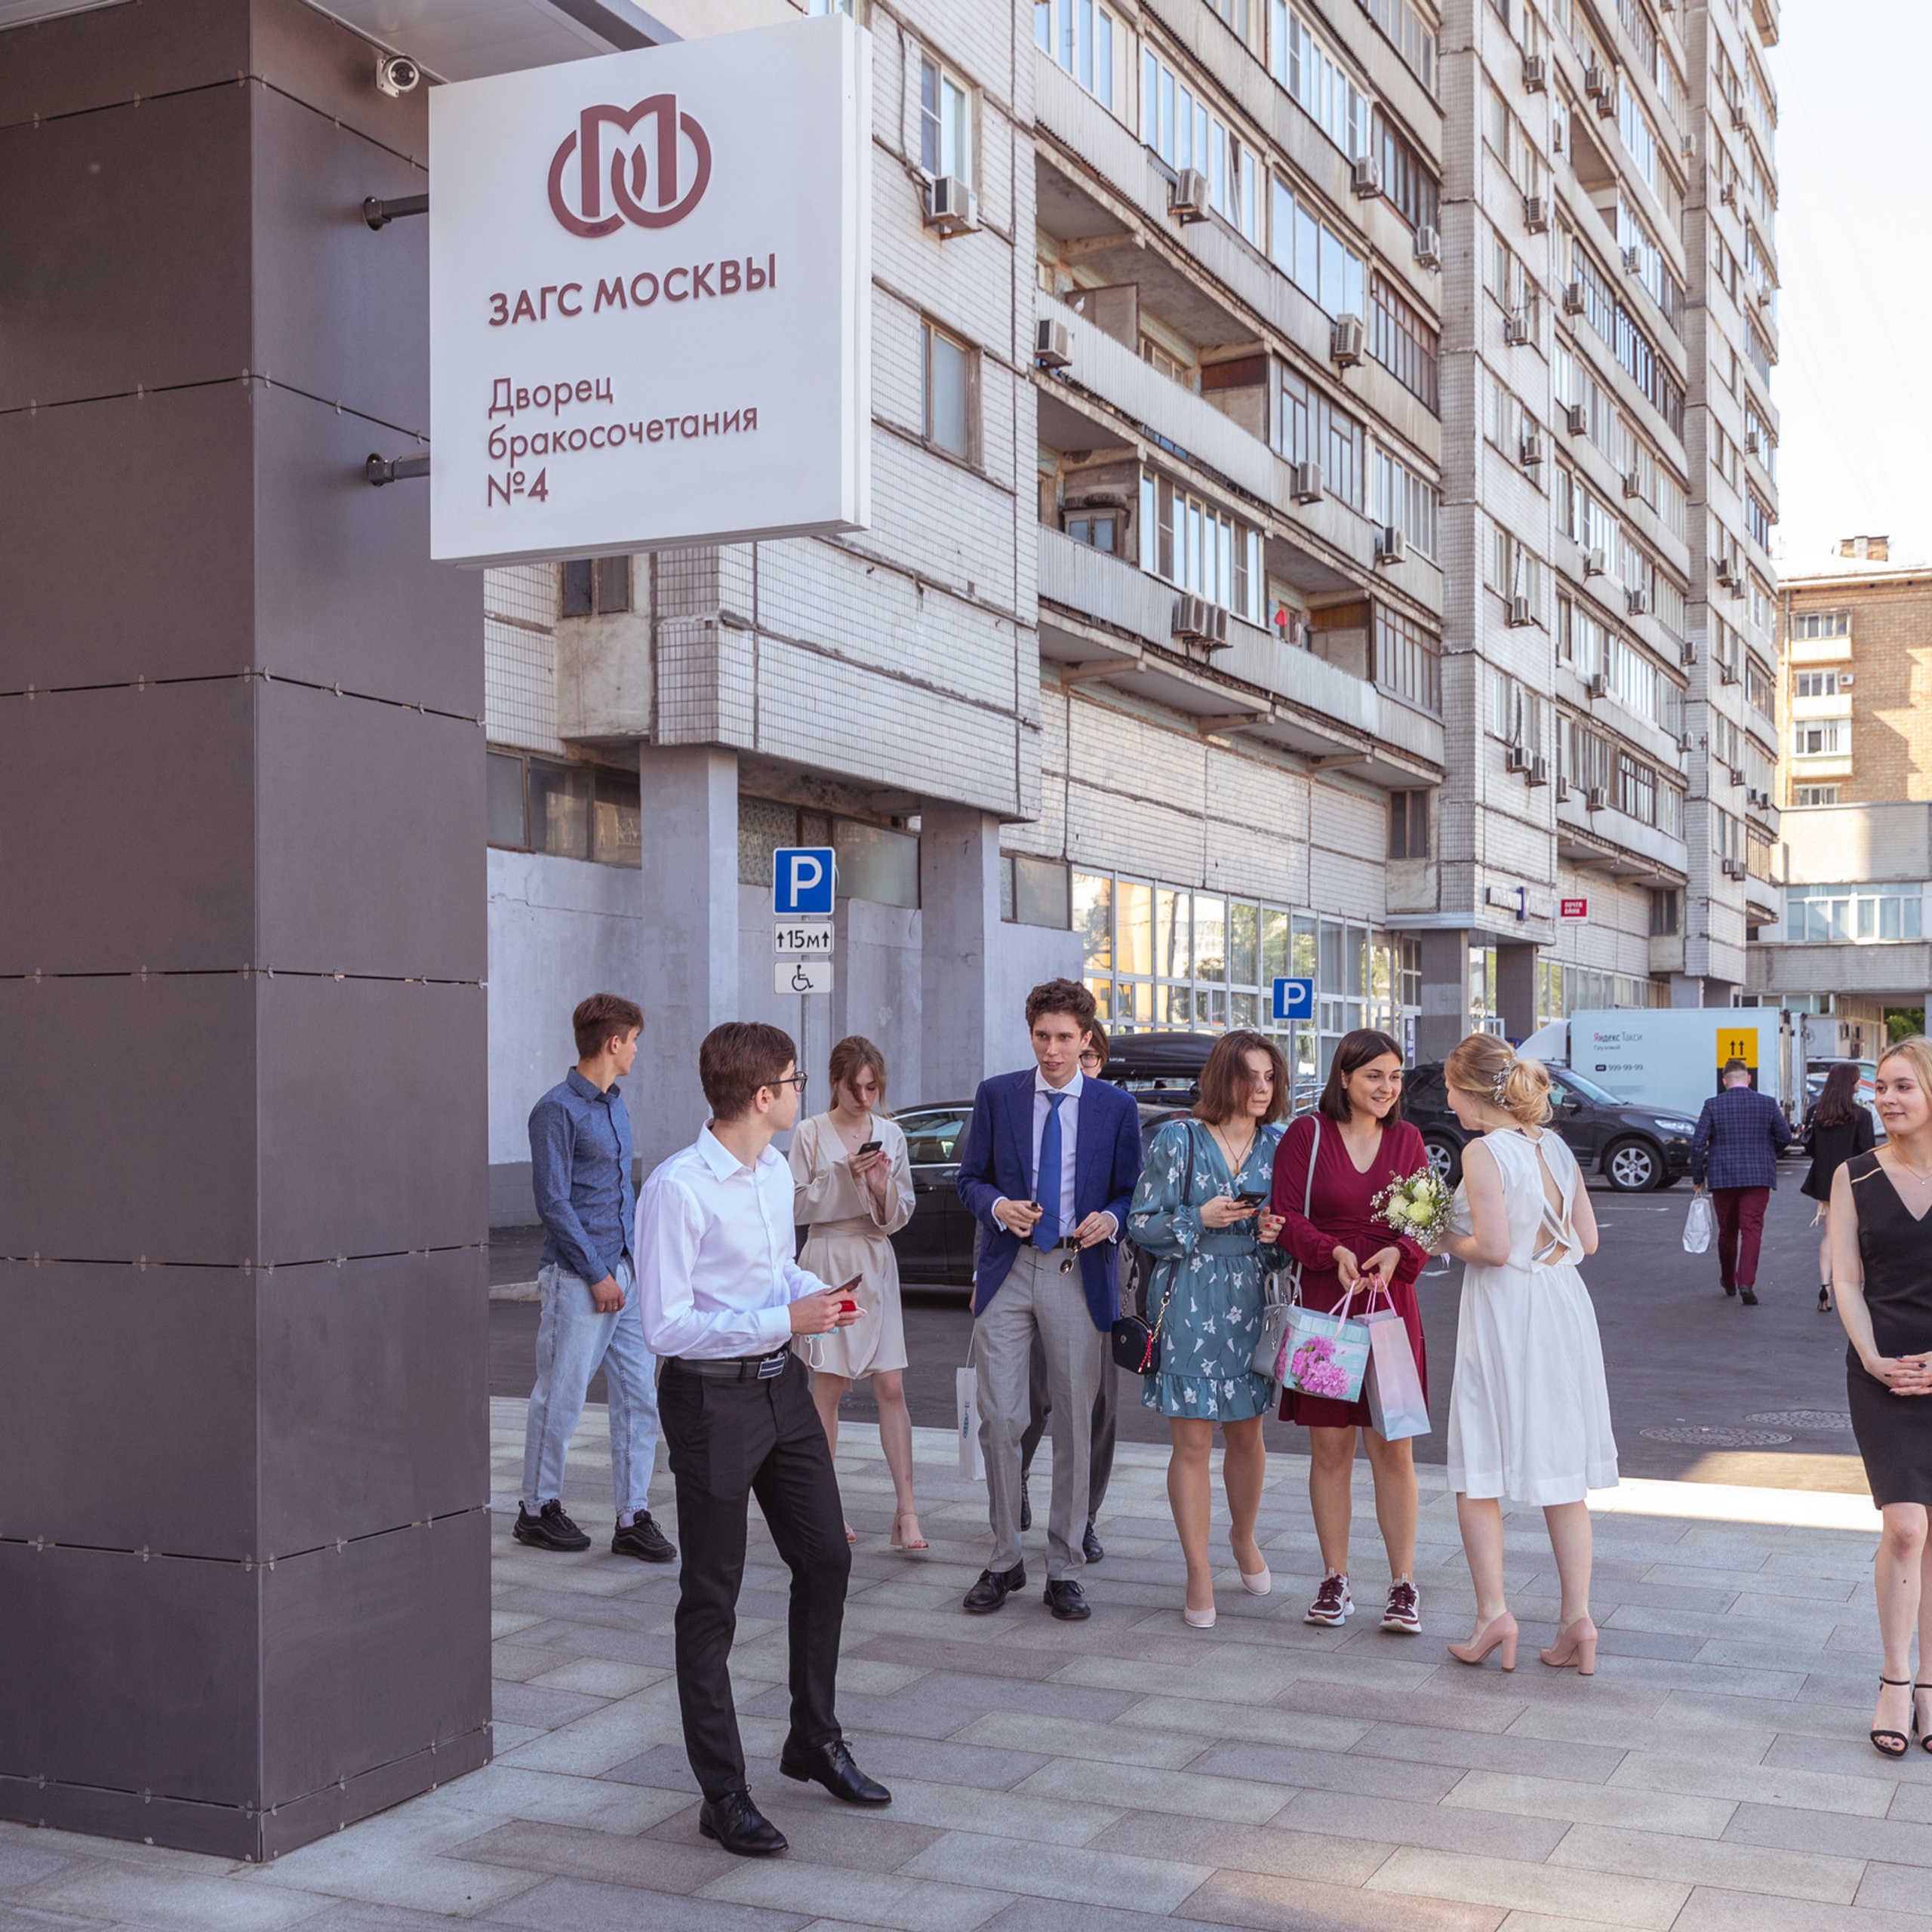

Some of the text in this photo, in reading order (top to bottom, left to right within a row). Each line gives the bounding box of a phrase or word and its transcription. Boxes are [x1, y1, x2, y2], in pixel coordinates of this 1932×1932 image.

[489, 254, 776, 326] ЗАГС МОСКВЫ
[488, 377, 613, 419] Дворец
[488, 408, 757, 468] бракосочетания
[488, 468, 549, 506] №4
[790, 856, 823, 907] P
[1284, 982, 1306, 1015] P
[1594, 1032, 1620, 1042] Яндекс
